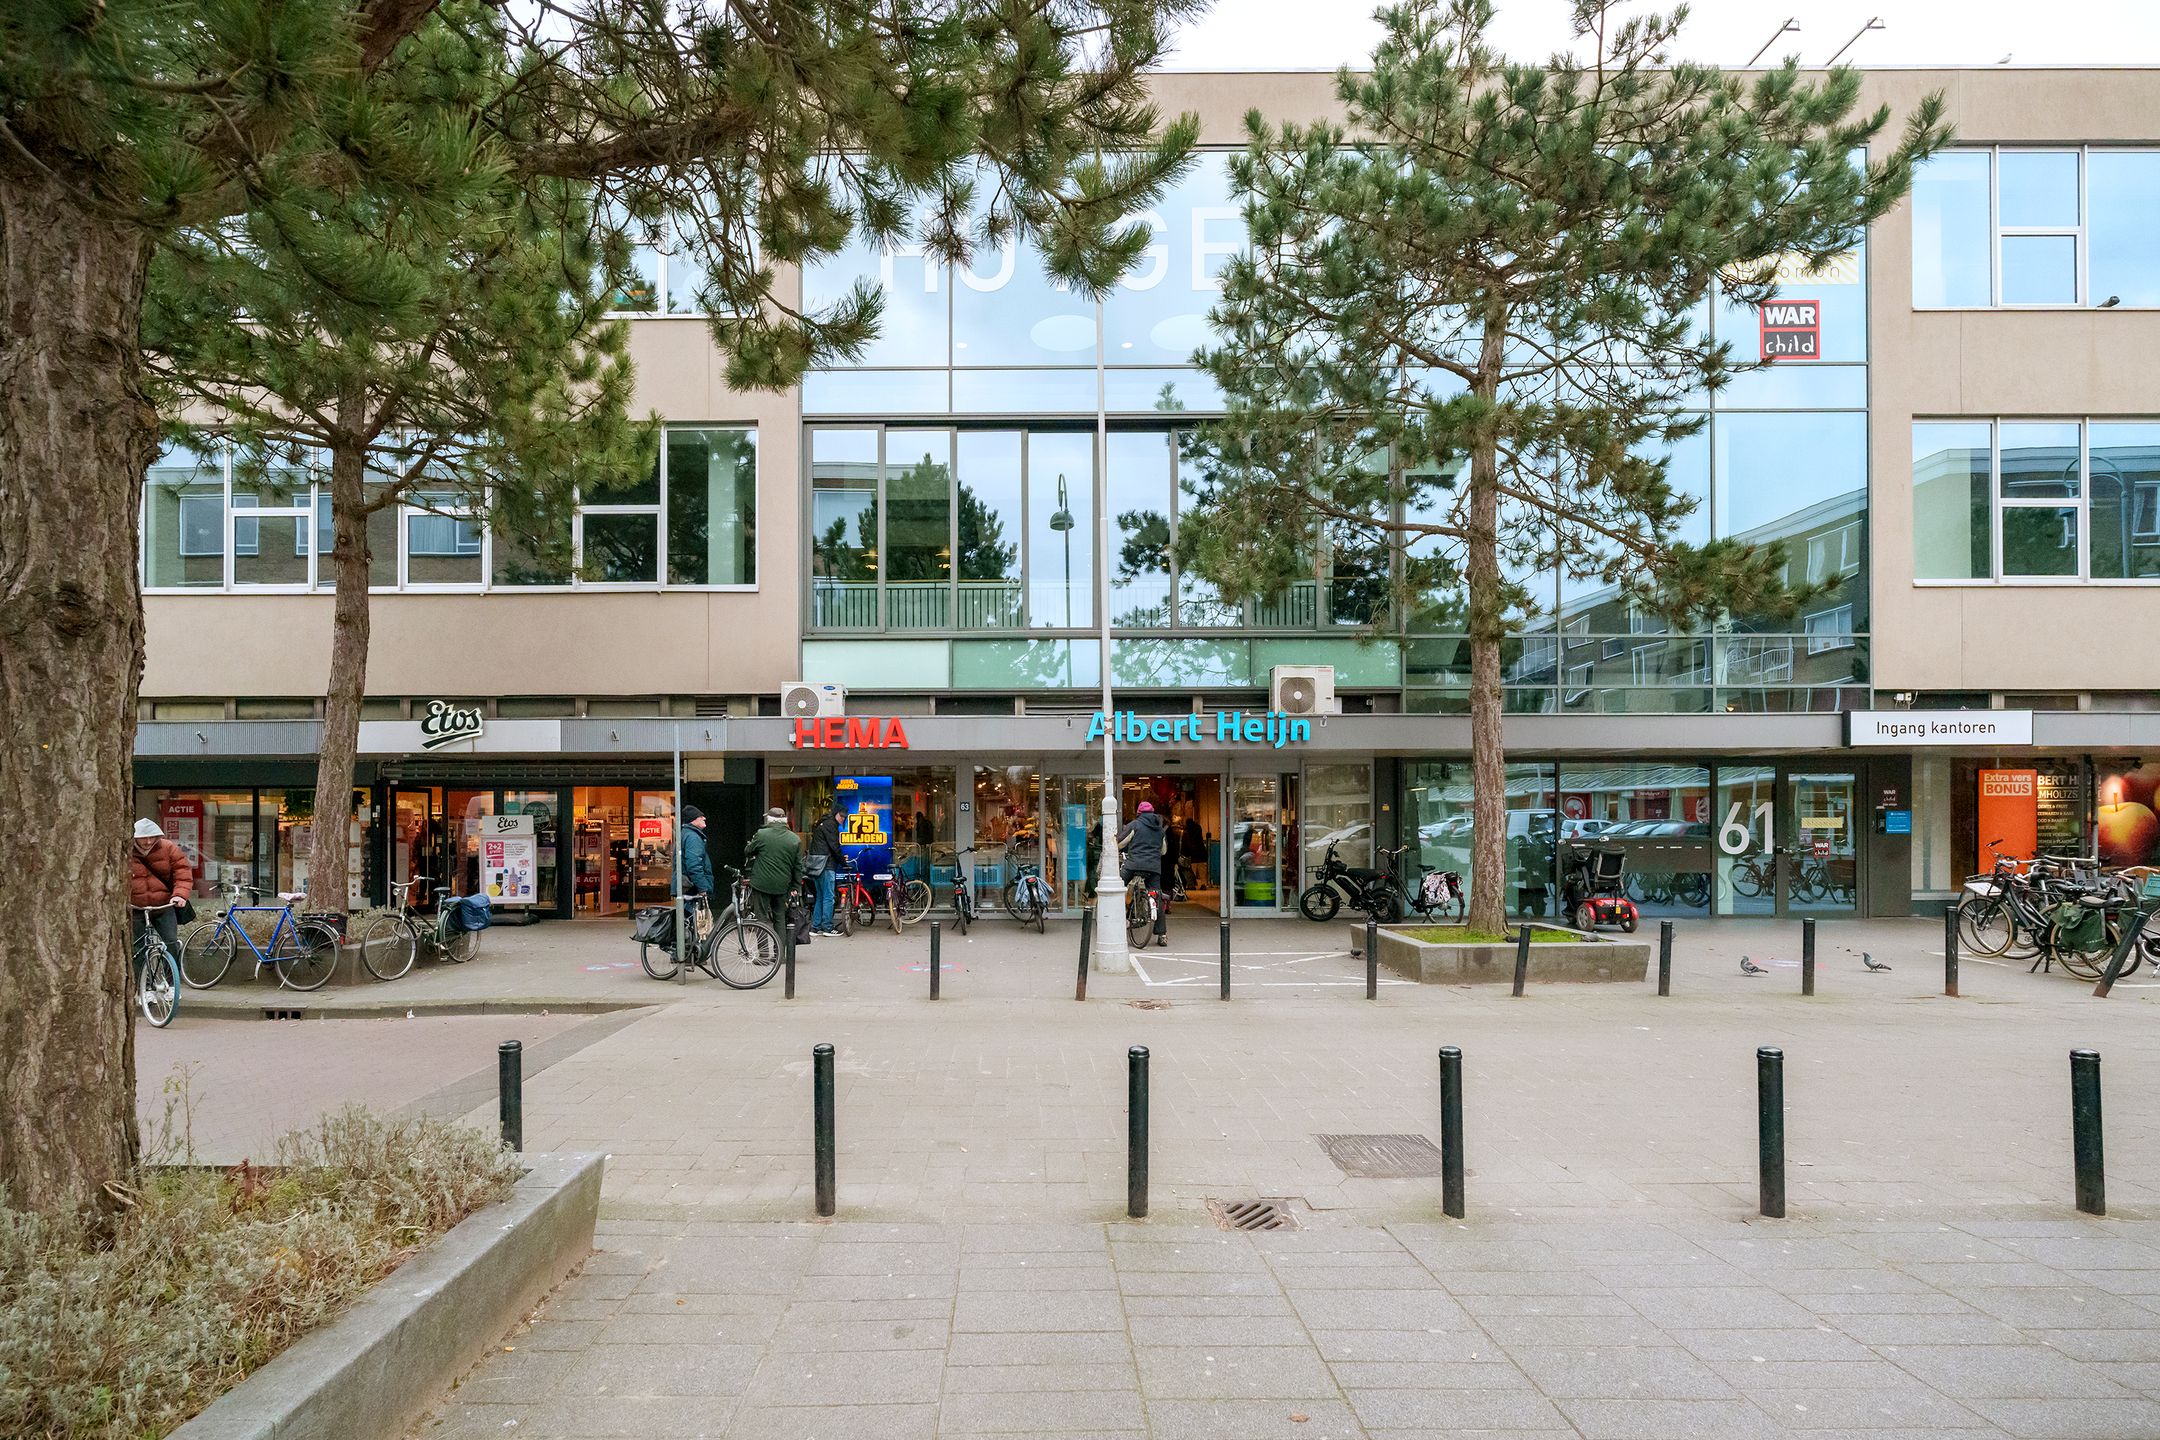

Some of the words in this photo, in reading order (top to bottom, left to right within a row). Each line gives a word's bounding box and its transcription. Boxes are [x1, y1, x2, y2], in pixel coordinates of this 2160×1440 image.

[1764, 306, 1816, 325] WAR
[1765, 334, 1815, 354] child
[421, 701, 481, 735] Etos
[796, 717, 909, 749] HEMA
[1086, 711, 1203, 743] Albert
[1217, 711, 1311, 749] Heijn
[1876, 721, 1926, 738] Ingang
[1931, 721, 1996, 735] kantoren
[1984, 774, 2009, 783] Extra
[2011, 774, 2032, 783] vers
[1986, 784, 2030, 795] BONUS
[960, 803, 969, 811] 63
[497, 816, 519, 828] Etos
[850, 815, 874, 833] 75
[1718, 802, 1774, 855] 61
[841, 833, 883, 843] MILJOEN
